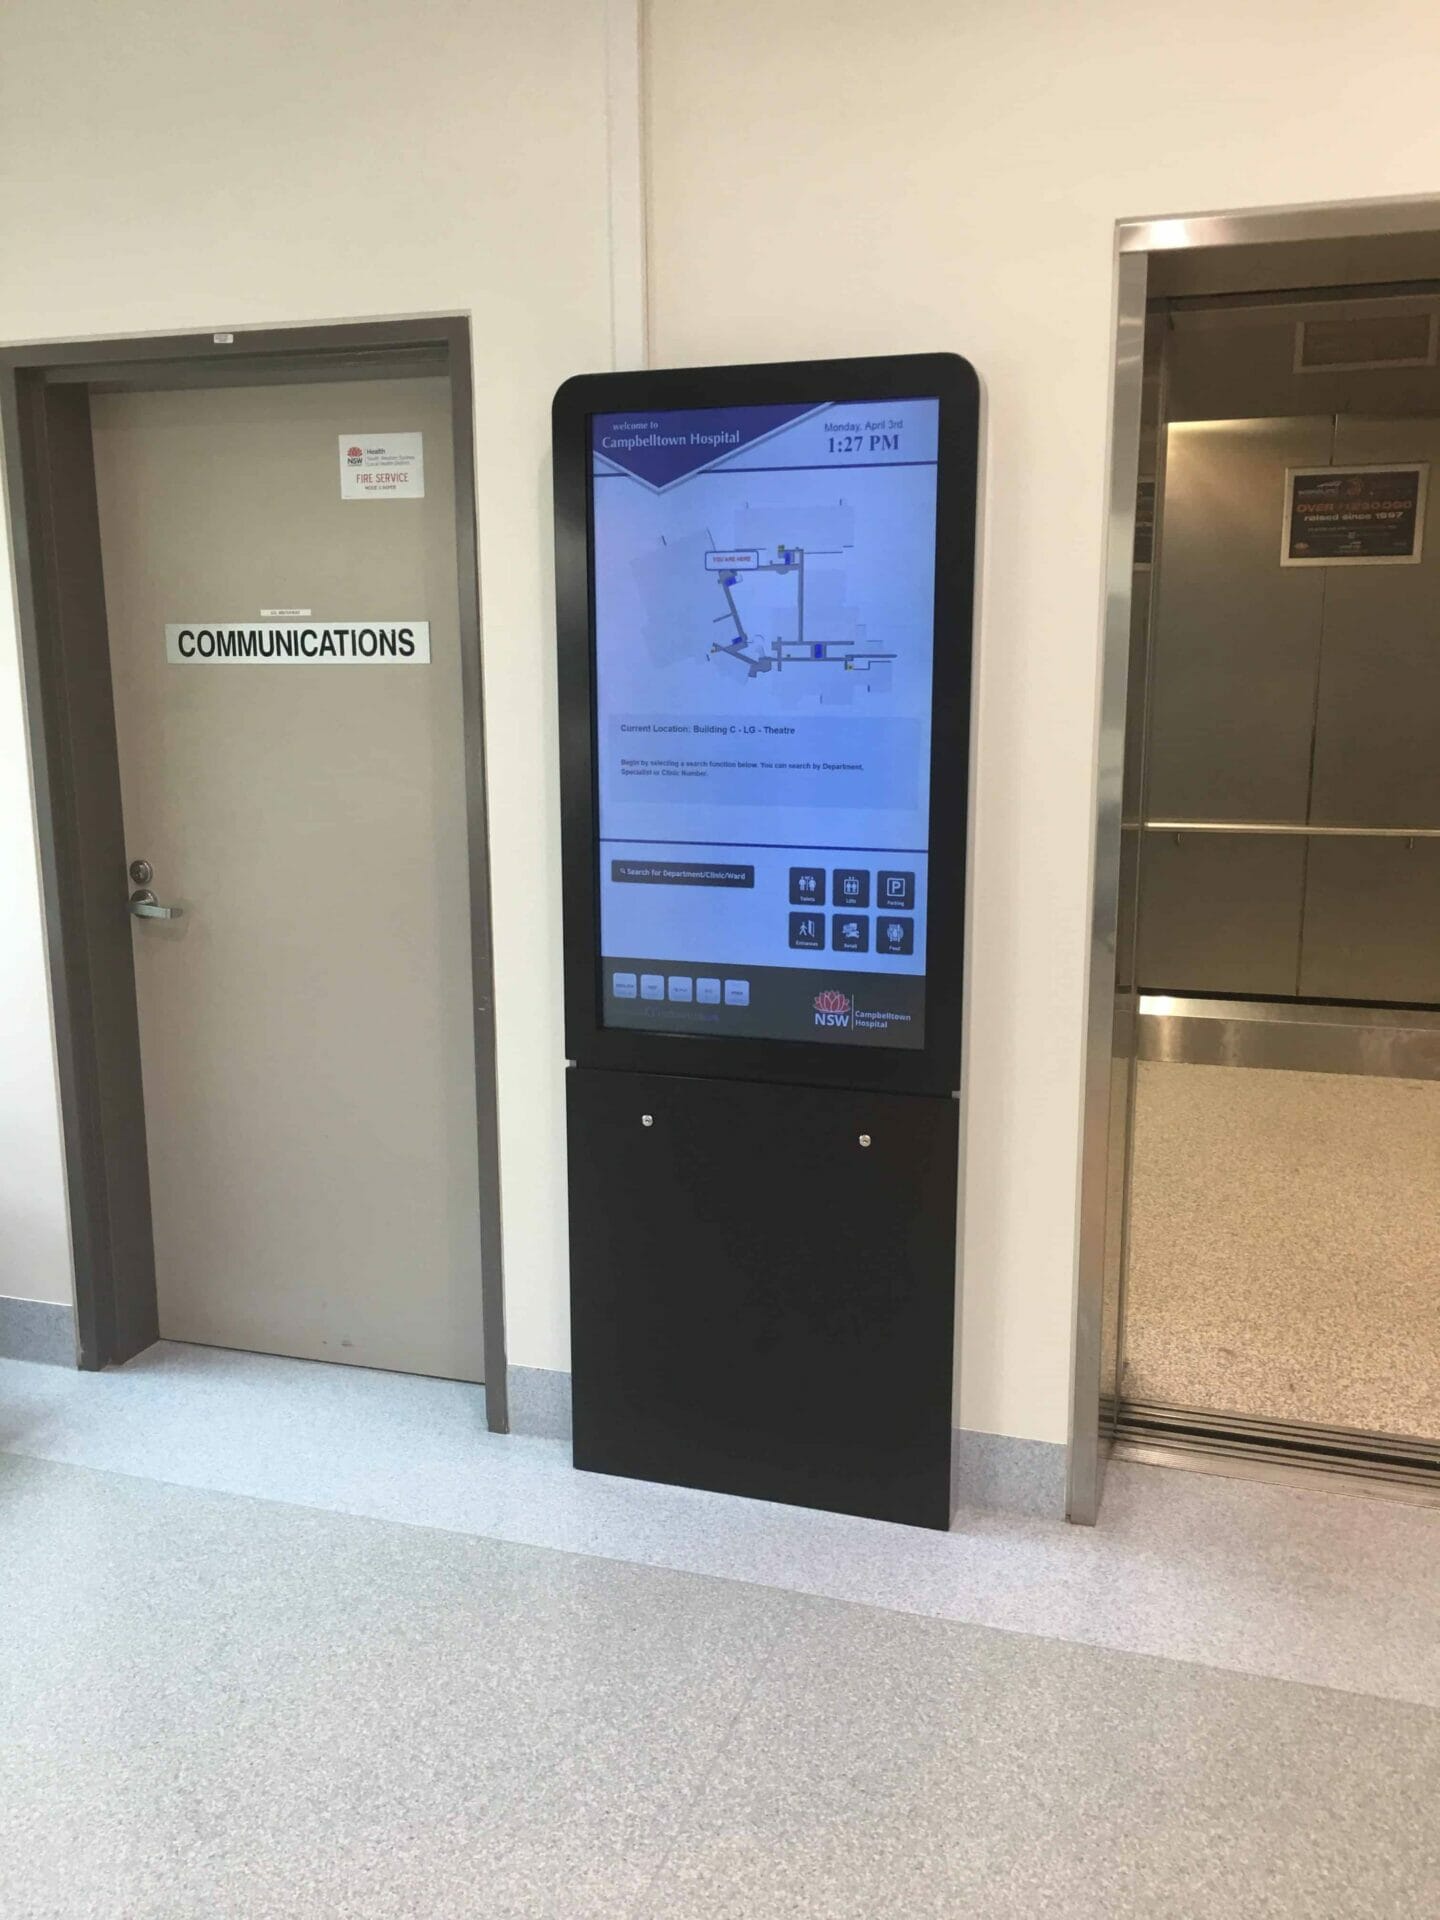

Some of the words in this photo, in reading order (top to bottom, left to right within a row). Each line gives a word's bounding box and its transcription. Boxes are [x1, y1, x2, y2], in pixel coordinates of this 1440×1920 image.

[612, 421, 648, 431] welcome
[650, 421, 659, 430] to
[824, 422, 862, 433] Monday,
[865, 420, 886, 431] April
[888, 419, 904, 429] 3rd
[602, 434, 687, 451] Campbelltown
[690, 430, 740, 447] Hospital
[828, 436, 863, 453] 1:27
[869, 434, 899, 451] PM
[347, 457, 363, 465] NSW
[356, 473, 374, 484] FIRE
[375, 472, 409, 483] SERVICE
[178, 629, 415, 657] COMMUNICATIONS
[620, 724, 651, 733] Current
[653, 724, 692, 733] Location:
[693, 725, 728, 735] Building
[729, 726, 736, 734] C
[743, 726, 756, 734] LG
[764, 726, 796, 735] Theatre
[621, 759, 640, 767] Begin
[650, 760, 679, 768] selecting
[812, 762, 821, 771] by
[626, 868, 650, 877] Search
[651, 868, 662, 877] for
[663, 869, 746, 880] Department/Clinic/Ward
[891, 881, 901, 894] P
[814, 1013, 849, 1027] NSW
[855, 1010, 911, 1021] Campbelltown
[855, 1019, 888, 1029] Hospital
